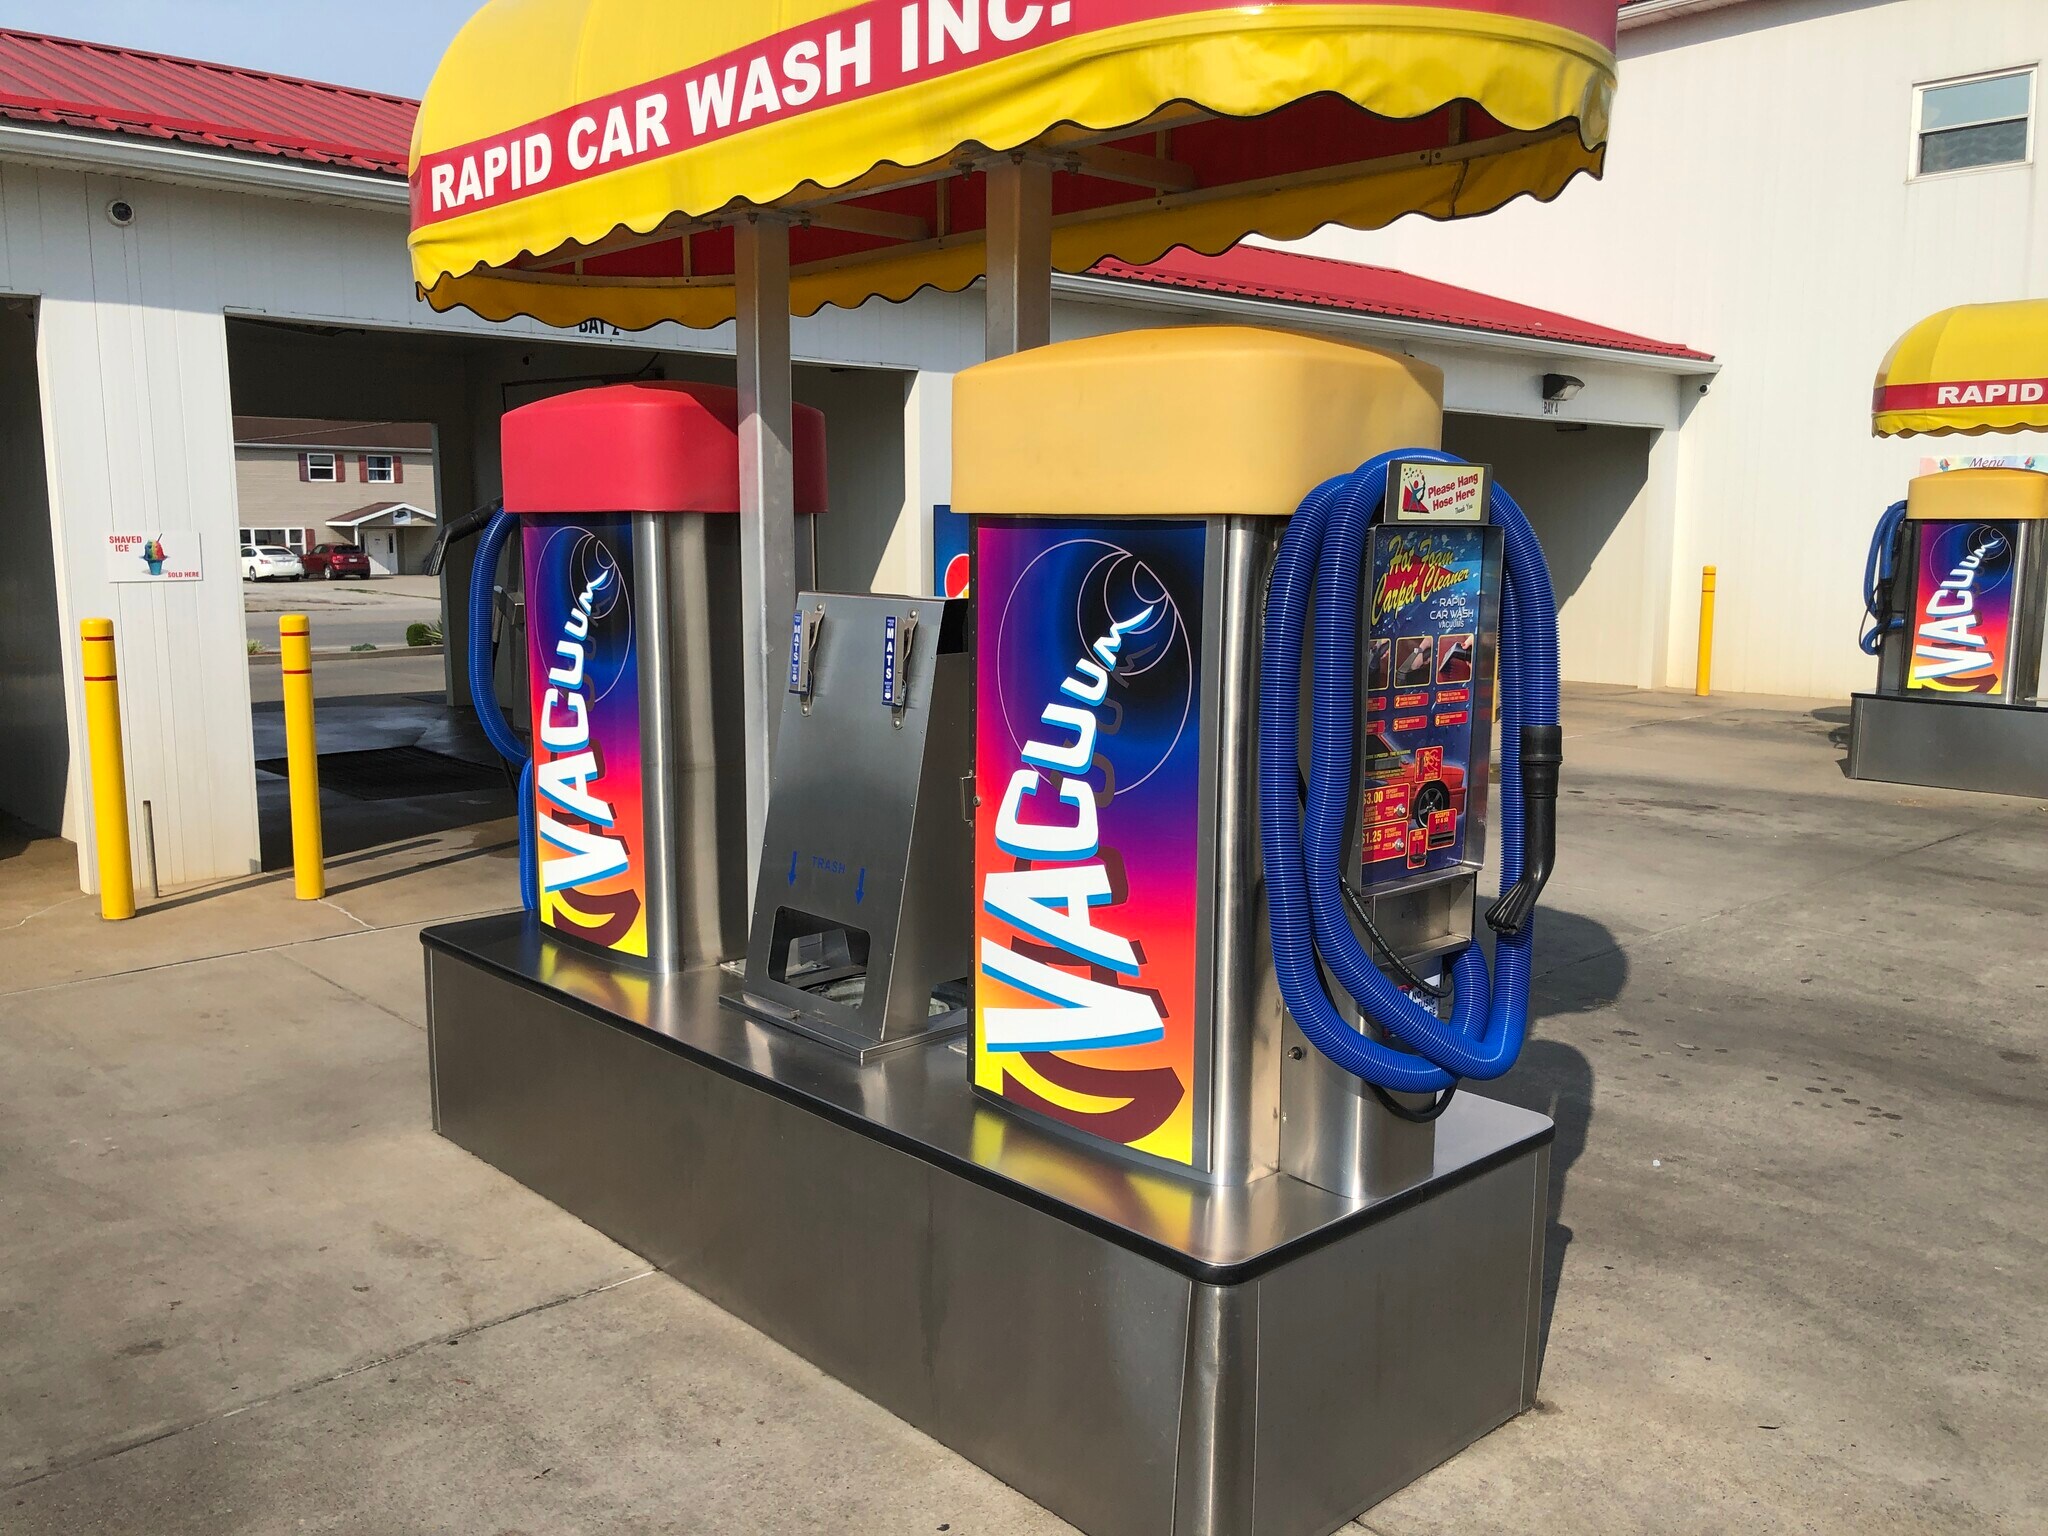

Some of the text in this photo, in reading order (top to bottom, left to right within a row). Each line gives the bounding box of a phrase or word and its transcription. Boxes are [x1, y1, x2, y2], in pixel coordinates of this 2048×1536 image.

[431, 0, 1071, 213] RAPID CAR WASH INC.
[1937, 383, 2044, 405] RAPID
[1544, 401, 1559, 415] BAY 4
[1969, 457, 2005, 468] Menu
[1427, 473, 1479, 499] Please Hang
[1432, 487, 1476, 511] Hose Here
[109, 535, 142, 544] SHAVED
[115, 544, 130, 553] ICE
[1388, 534, 1454, 578] Hot Foam
[1371, 564, 1470, 627] Carpet Cleaner
[1439, 597, 1466, 607] RAPID
[1429, 608, 1474, 620] CAR WASH
[792, 624, 801, 662] MATS
[885, 627, 894, 680] MATS
[1395, 696, 1400, 707] 2
[1437, 693, 1442, 703] 3
[1393, 720, 1398, 731] 5
[811, 855, 846, 874] TRASH
[1412, 991, 1422, 999] NO
